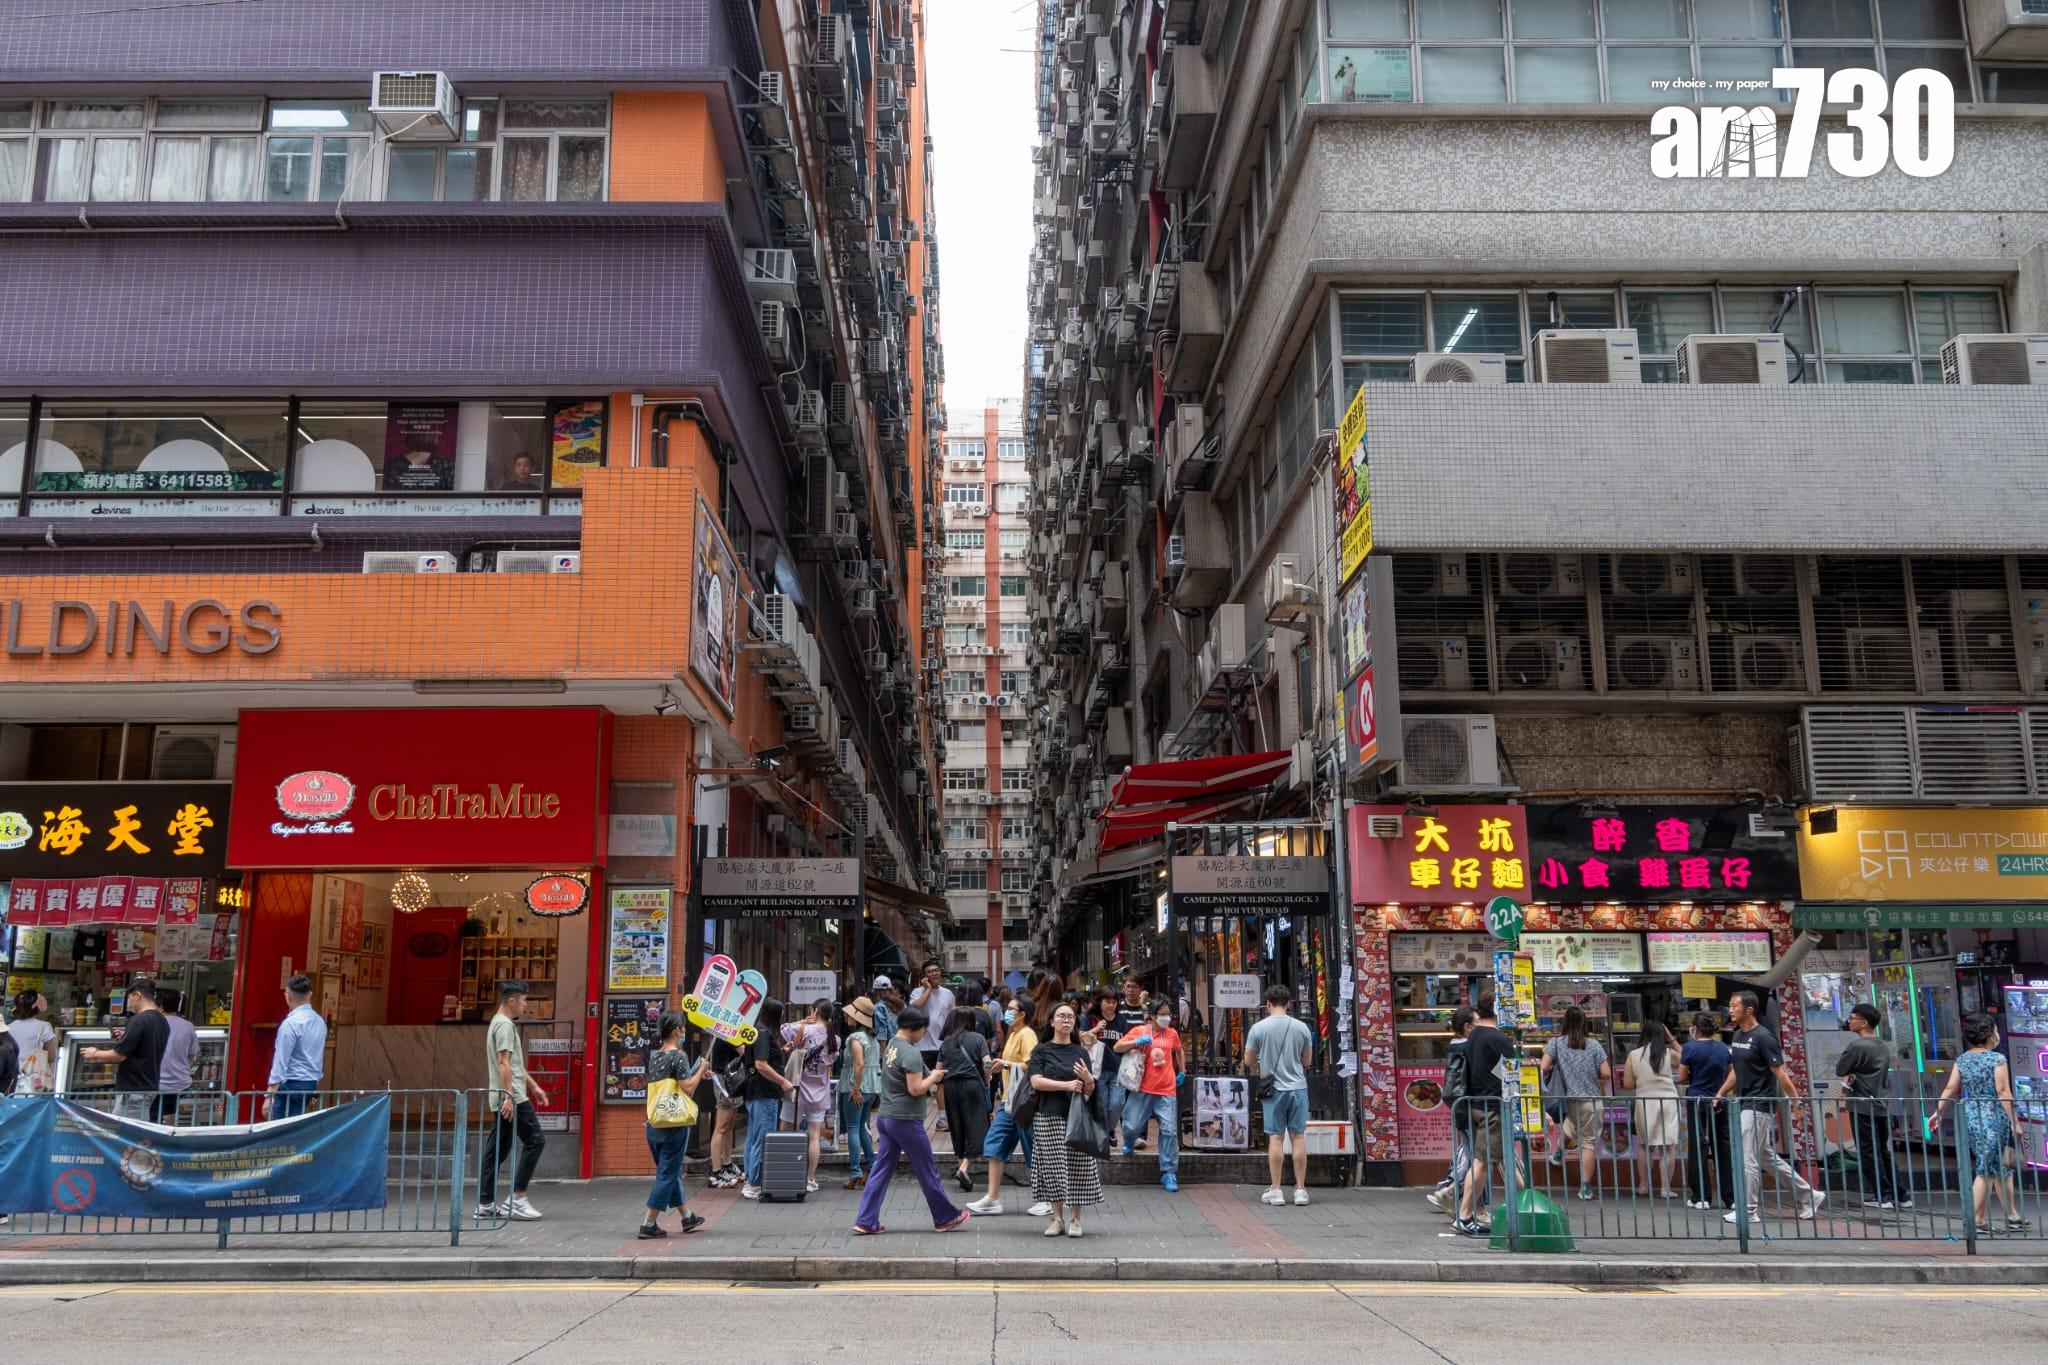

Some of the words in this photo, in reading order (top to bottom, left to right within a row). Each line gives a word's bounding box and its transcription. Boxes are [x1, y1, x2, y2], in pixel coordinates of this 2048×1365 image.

[91, 503, 132, 515] davines
[201, 504, 214, 513] The
[215, 504, 230, 513] Hair
[304, 503, 345, 515] davines
[413, 504, 426, 513] The
[427, 504, 443, 513] Hair
[1674, 565, 1688, 577] 12
[0, 599, 282, 657] LDINGS
[368, 783, 561, 820] ChaTraMue
[38, 803, 215, 856] 海天堂
[271, 822, 307, 838] Original
[308, 821, 333, 835] Thai
[333, 821, 355, 834] Tea
[1414, 818, 1515, 854] 大坑
[1590, 817, 1693, 854] 醉香
[2000, 856, 2048, 873] 24HR
[1409, 857, 1525, 890] 車仔麵
[1538, 857, 1611, 890] 小食
[1638, 856, 1753, 890] 雞蛋仔
[13, 883, 160, 913] 消費券優惠
[704, 898, 759, 906] CAMELPAINT
[760, 898, 806, 906] BUILDINGS
[806, 898, 836, 906] BLOCK
[842, 898, 851, 906] &
[851, 898, 856, 906] 2
[1183, 895, 1237, 904] CAMELPAINT
[1238, 895, 1283, 904] BUILDINGS
[1284, 895, 1314, 904] BLOCK
[1314, 895, 1320, 903] 3
[742, 909, 751, 918] 62
[752, 909, 769, 918] HOI
[770, 909, 793, 918] YUEN
[794, 909, 818, 918] ROAD
[1214, 906, 1223, 914] 60
[1224, 906, 1240, 914] HOI
[1240, 906, 1264, 914] YUEN
[1265, 906, 1290, 914] ROAD
[1489, 903, 1523, 932] 22A
[76, 1155, 105, 1165] PARKING
[201, 1160, 236, 1170] PARKING
[238, 1158, 255, 1168] WILL
[257, 1158, 267, 1167] BE
[212, 1170, 223, 1181] OR
[249, 1167, 272, 1178] AWAY
[205, 1199, 226, 1208] KWUN
[227, 1198, 245, 1207] TONG
[245, 1196, 269, 1206] POLICE
[270, 1194, 301, 1205] DISTRICT
